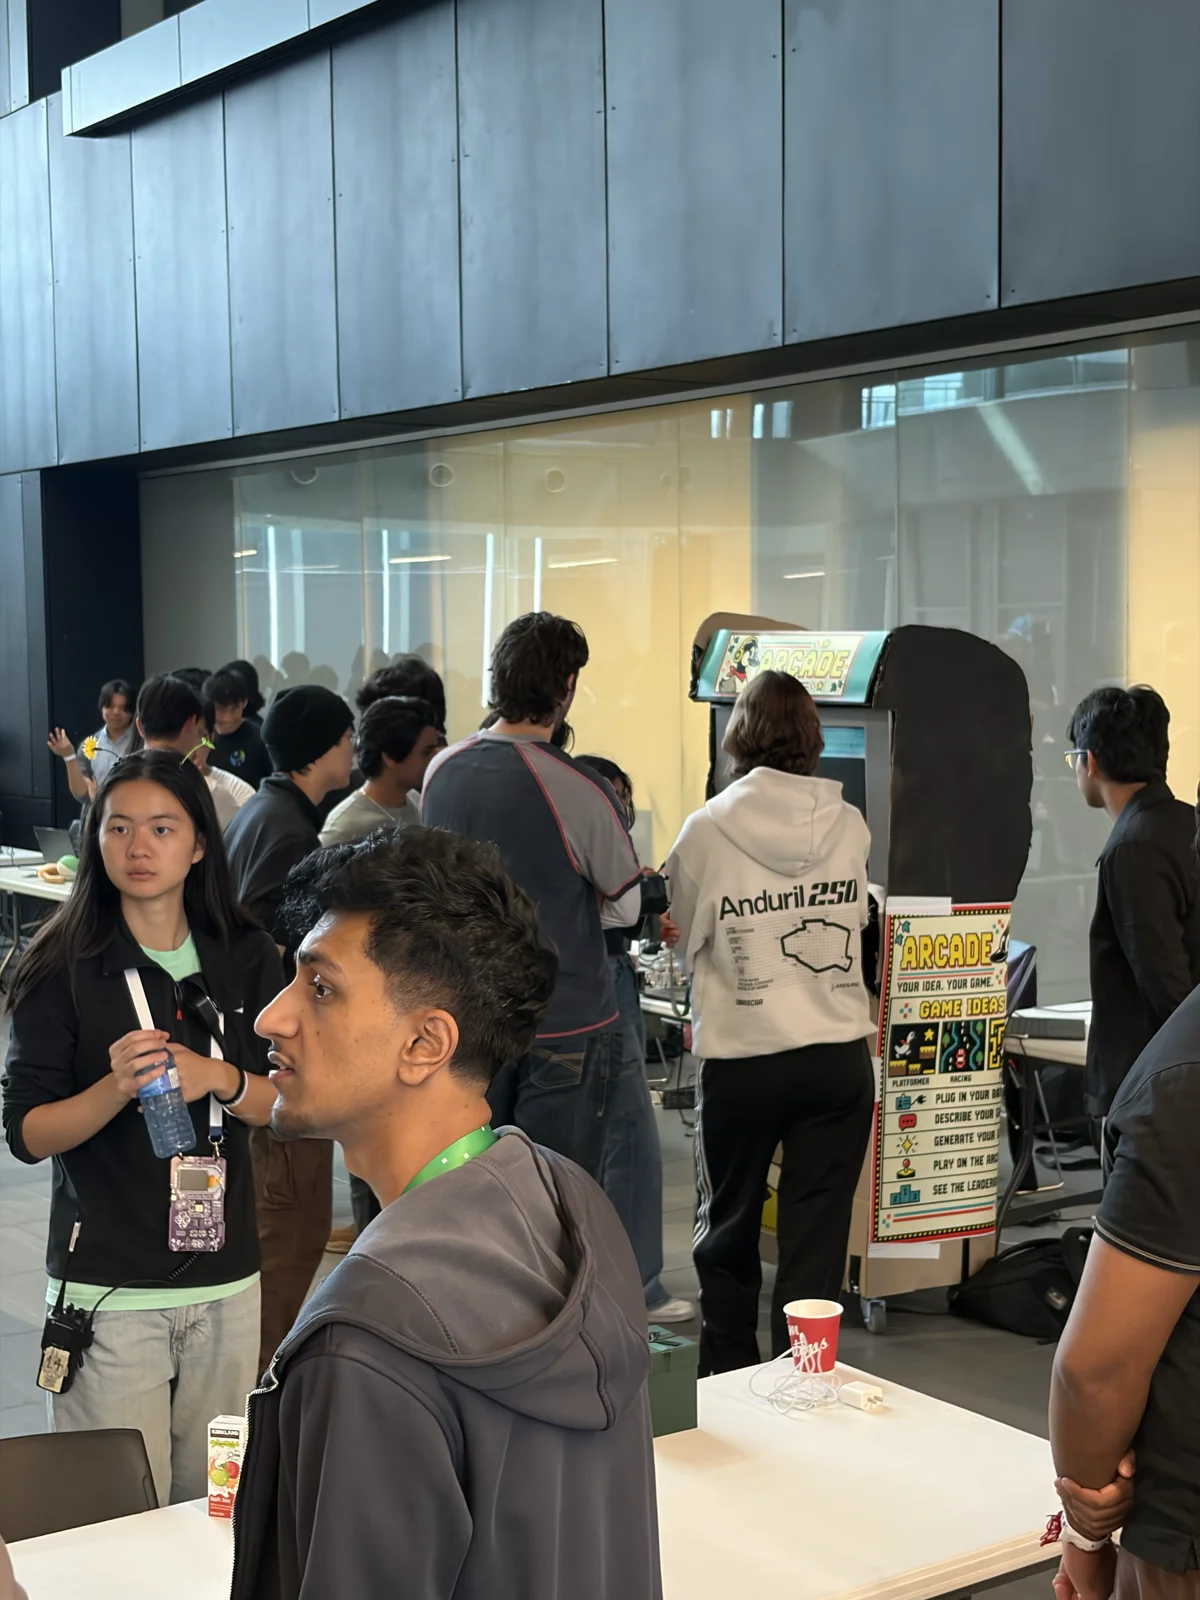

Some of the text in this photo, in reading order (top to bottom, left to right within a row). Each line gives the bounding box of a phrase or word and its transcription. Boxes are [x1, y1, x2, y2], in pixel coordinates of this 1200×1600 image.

[757, 649, 850, 679] ARCADE
[719, 879, 858, 921] Anduril 250
[900, 931, 993, 971] ARCADE
[897, 976, 994, 993] YOUR IDEA. YOUR GAME.
[919, 995, 1006, 1020] GAME IDEAS
[892, 1077, 930, 1088] PLATFORMER
[949, 1074, 972, 1084] RACING
[935, 1092, 956, 1104] PLUG
[958, 1091, 968, 1102] IN
[969, 1088, 990, 1101] YOUR
[934, 1110, 972, 1125] DESCRIBE
[974, 1108, 994, 1121] YOUR
[934, 1133, 975, 1147] GENERATE
[976, 1129, 996, 1142] YOUR
[933, 1159, 954, 1171] PLAY
[956, 1157, 968, 1169] ON
[970, 1156, 985, 1167] THE
[932, 1183, 949, 1196] SEE
[950, 1181, 965, 1194] THE
